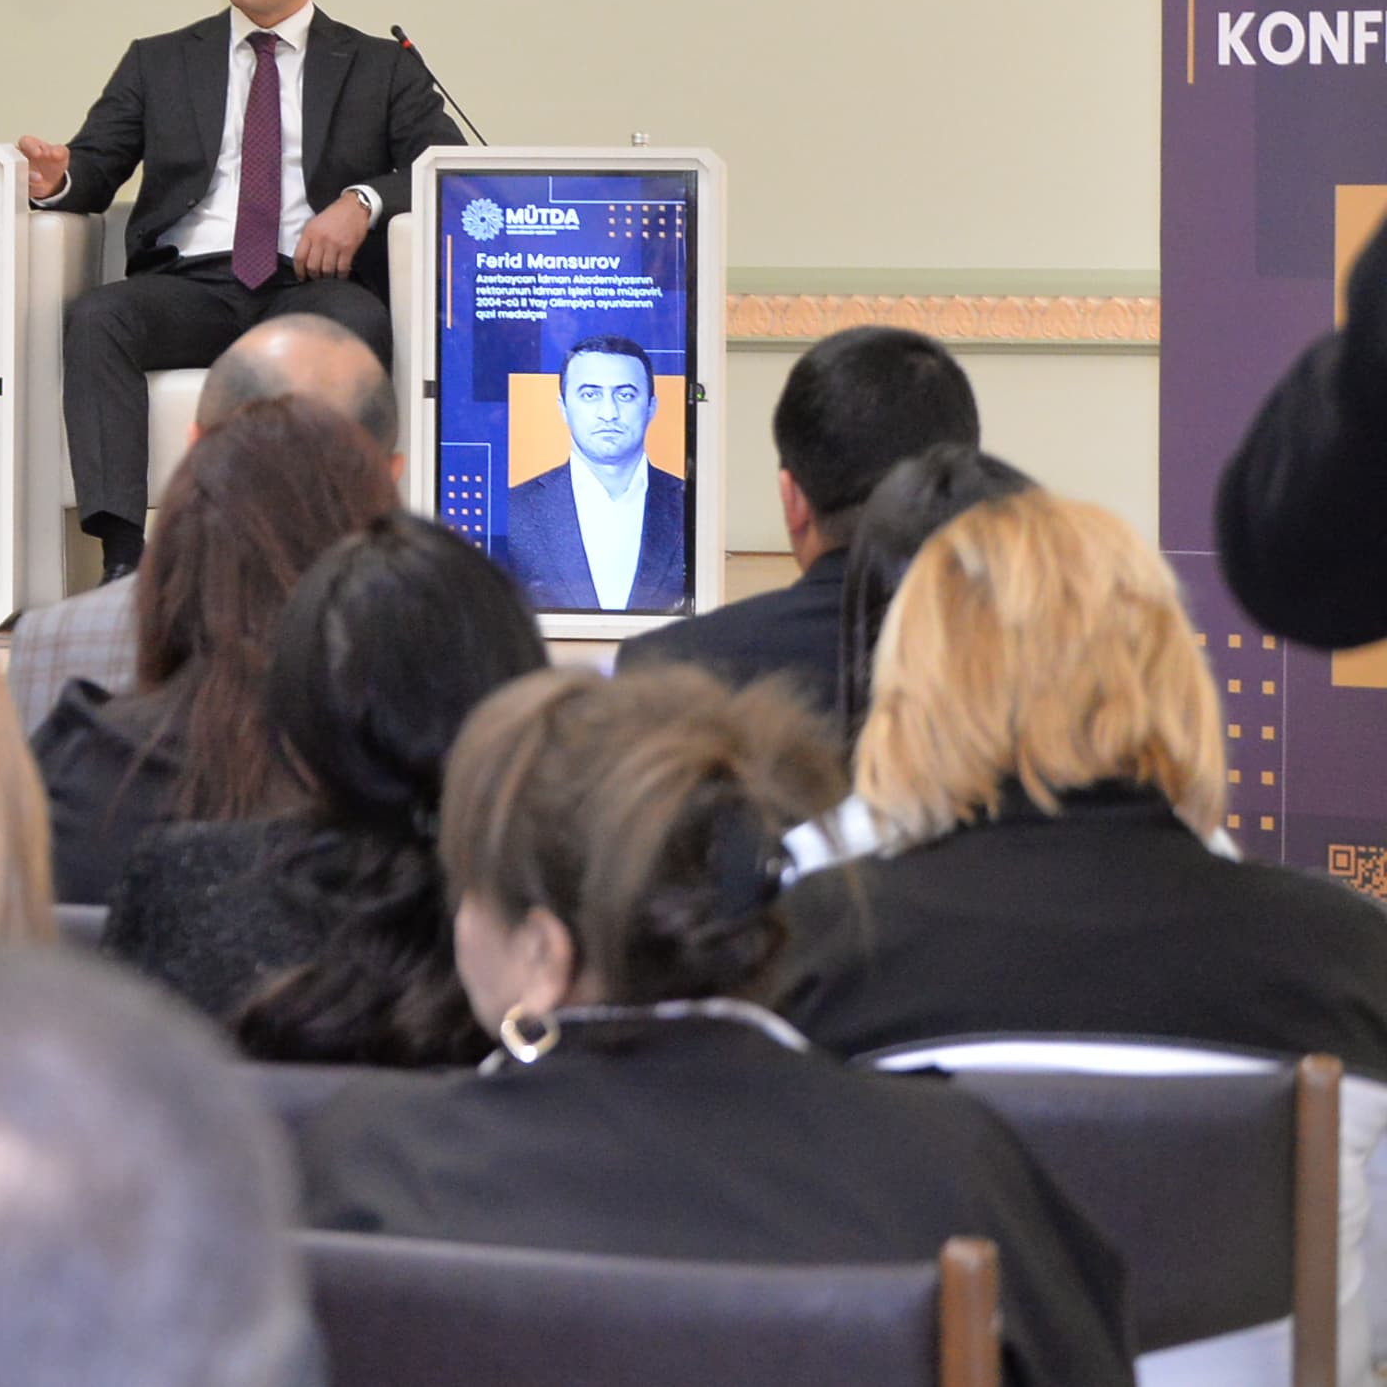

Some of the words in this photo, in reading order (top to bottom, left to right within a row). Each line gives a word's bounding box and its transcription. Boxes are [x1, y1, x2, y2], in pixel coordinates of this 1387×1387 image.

[1218, 10, 1387, 66] KONF
[506, 205, 579, 225] MÜTDA
[476, 252, 522, 269] Fərid
[527, 253, 620, 269] Mansurov
